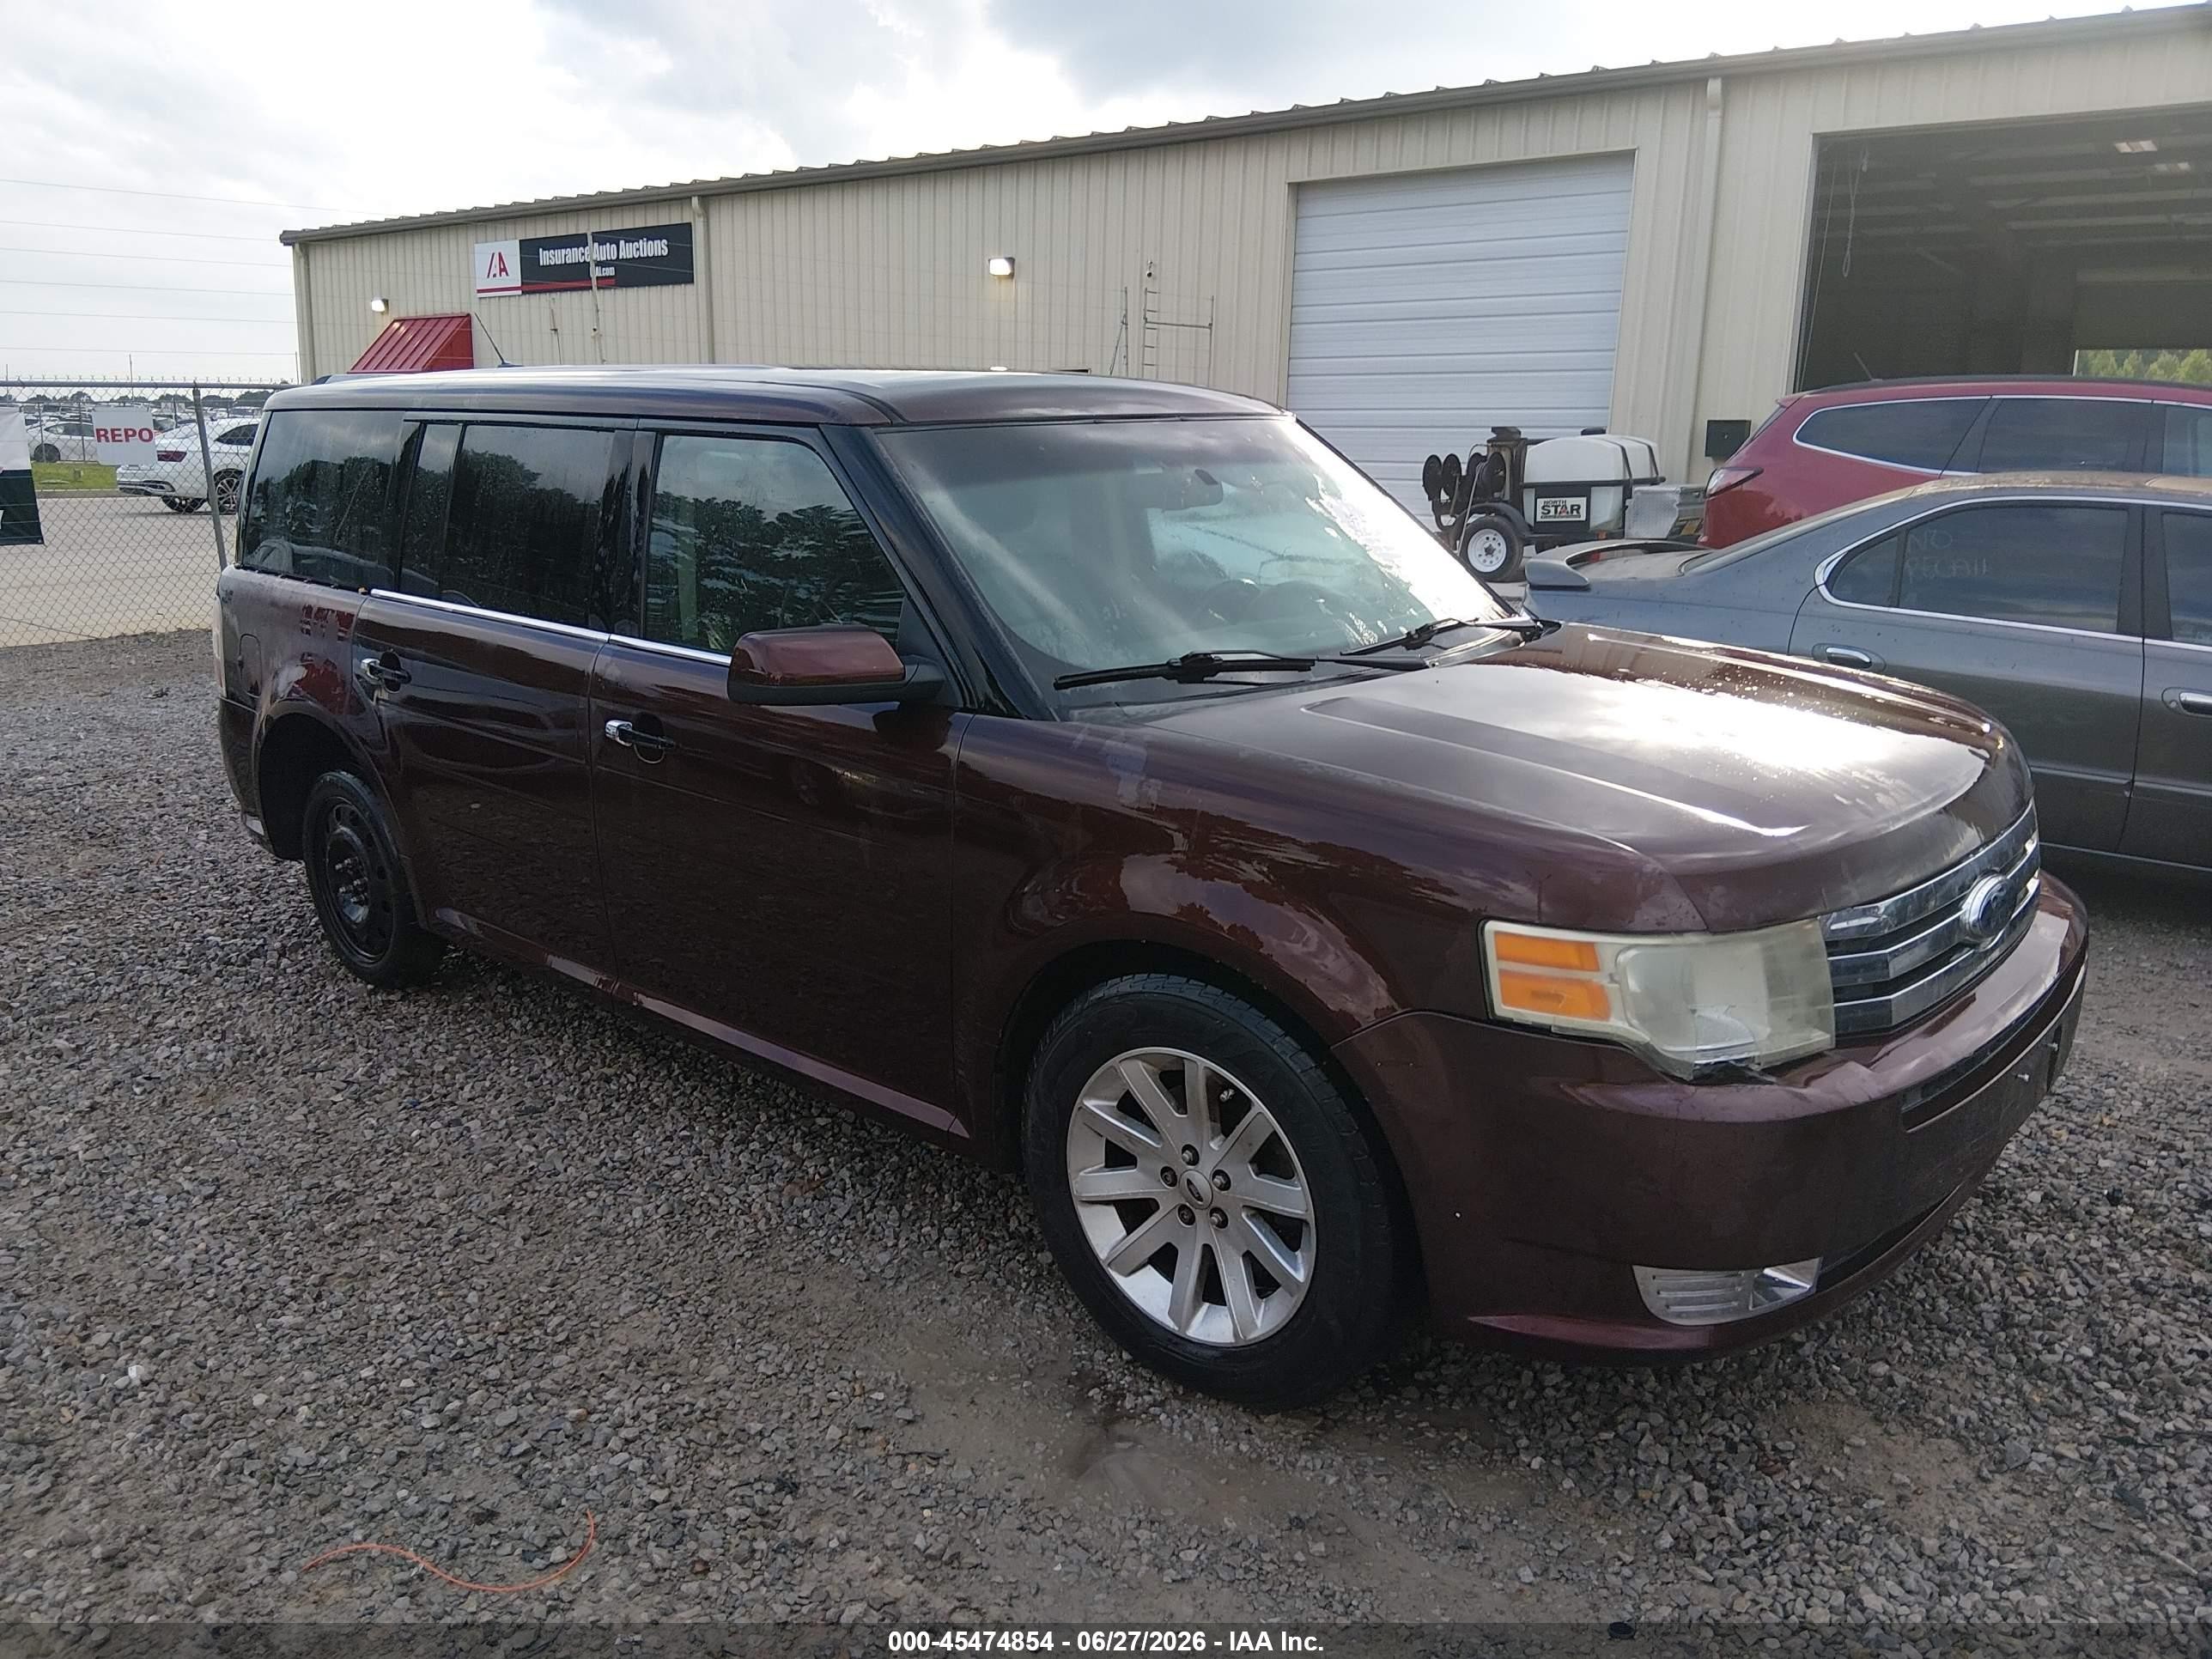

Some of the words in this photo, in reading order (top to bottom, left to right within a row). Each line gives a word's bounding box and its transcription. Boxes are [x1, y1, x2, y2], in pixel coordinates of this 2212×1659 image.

[539, 246, 590, 267] Insurance
[592, 240, 617, 260] Auto
[619, 237, 668, 259] Auctions
[95, 427, 155, 443] REPO
[1540, 504, 1582, 515] STAR
